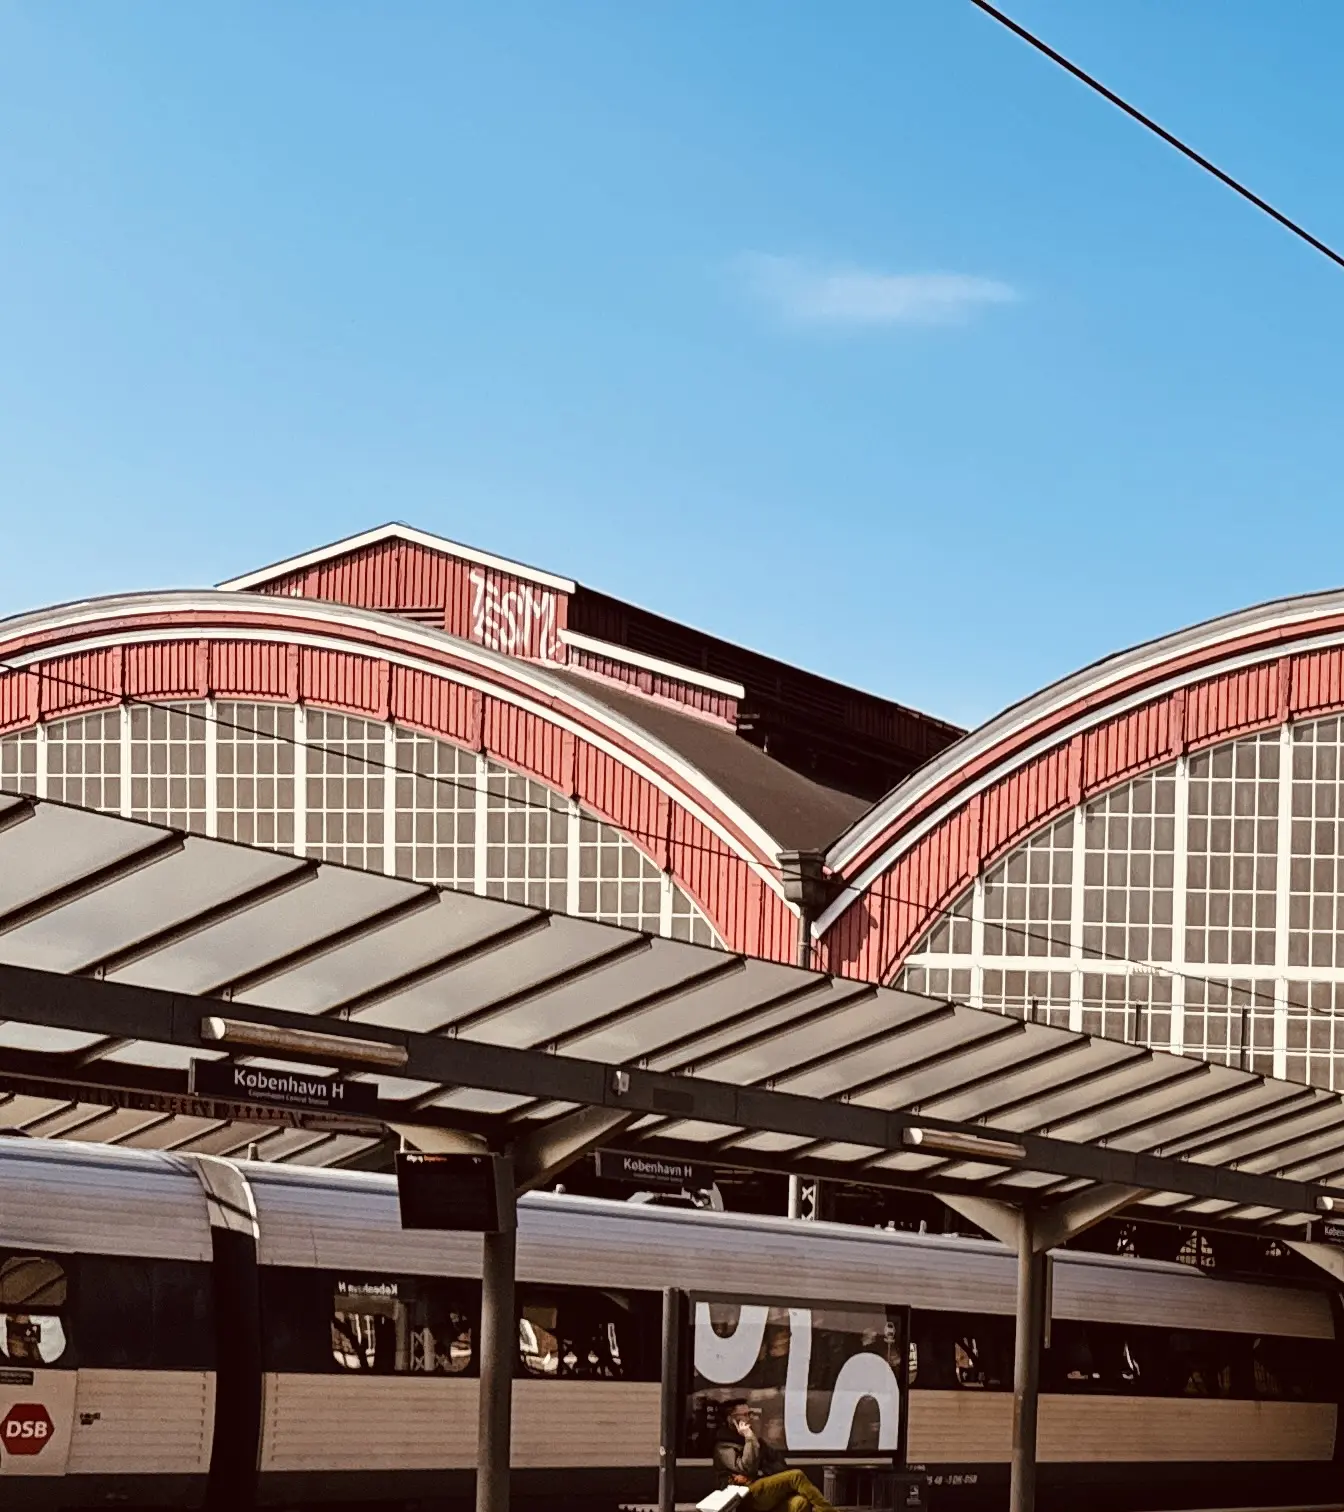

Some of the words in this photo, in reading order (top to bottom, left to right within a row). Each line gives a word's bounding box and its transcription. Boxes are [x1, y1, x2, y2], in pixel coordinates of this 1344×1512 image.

[234, 1069, 327, 1097] København
[332, 1082, 344, 1099] H
[623, 1157, 682, 1177] København
[684, 1165, 692, 1177] H
[6, 1420, 47, 1438] DSB
